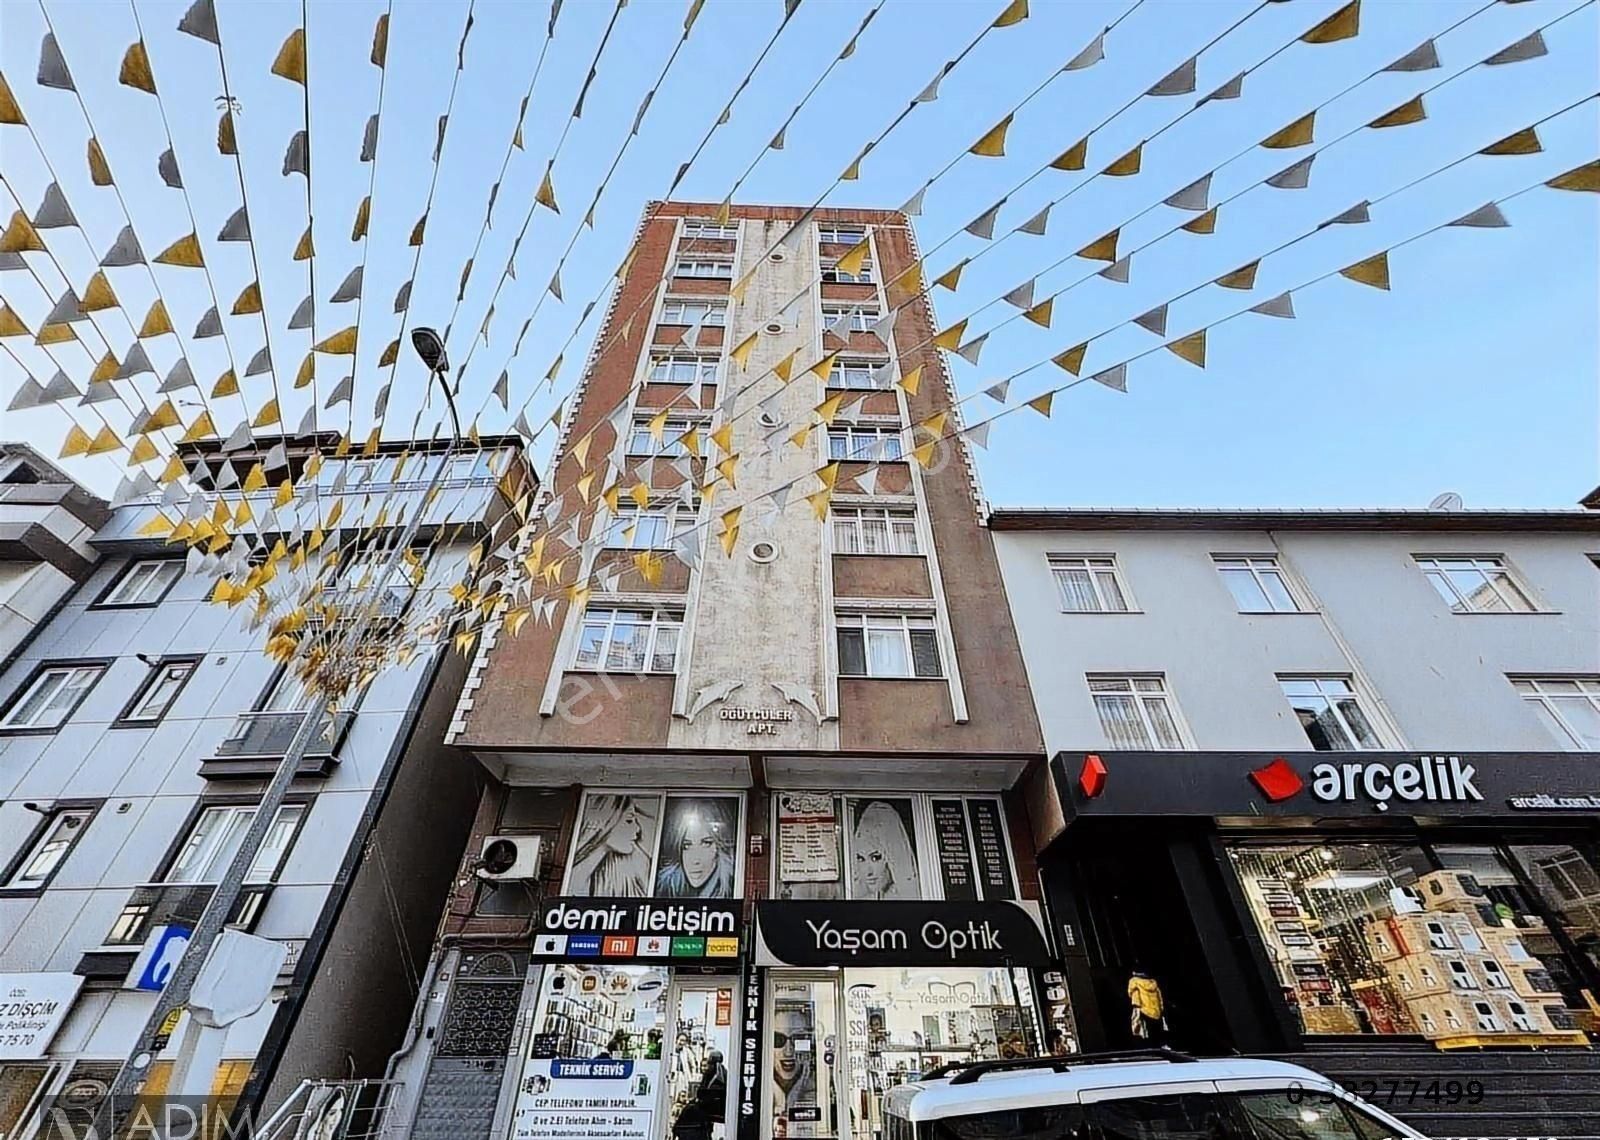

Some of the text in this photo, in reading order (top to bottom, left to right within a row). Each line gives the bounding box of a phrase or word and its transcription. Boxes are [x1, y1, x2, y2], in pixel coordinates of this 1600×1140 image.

[746, 723, 777, 735] APT.
[1312, 756, 1485, 811] arçelik
[545, 903, 734, 936] demir iletişim
[806, 919, 1003, 958] Yaşam Optik
[559, 1062, 625, 1076] TEKNİK SERVİS
